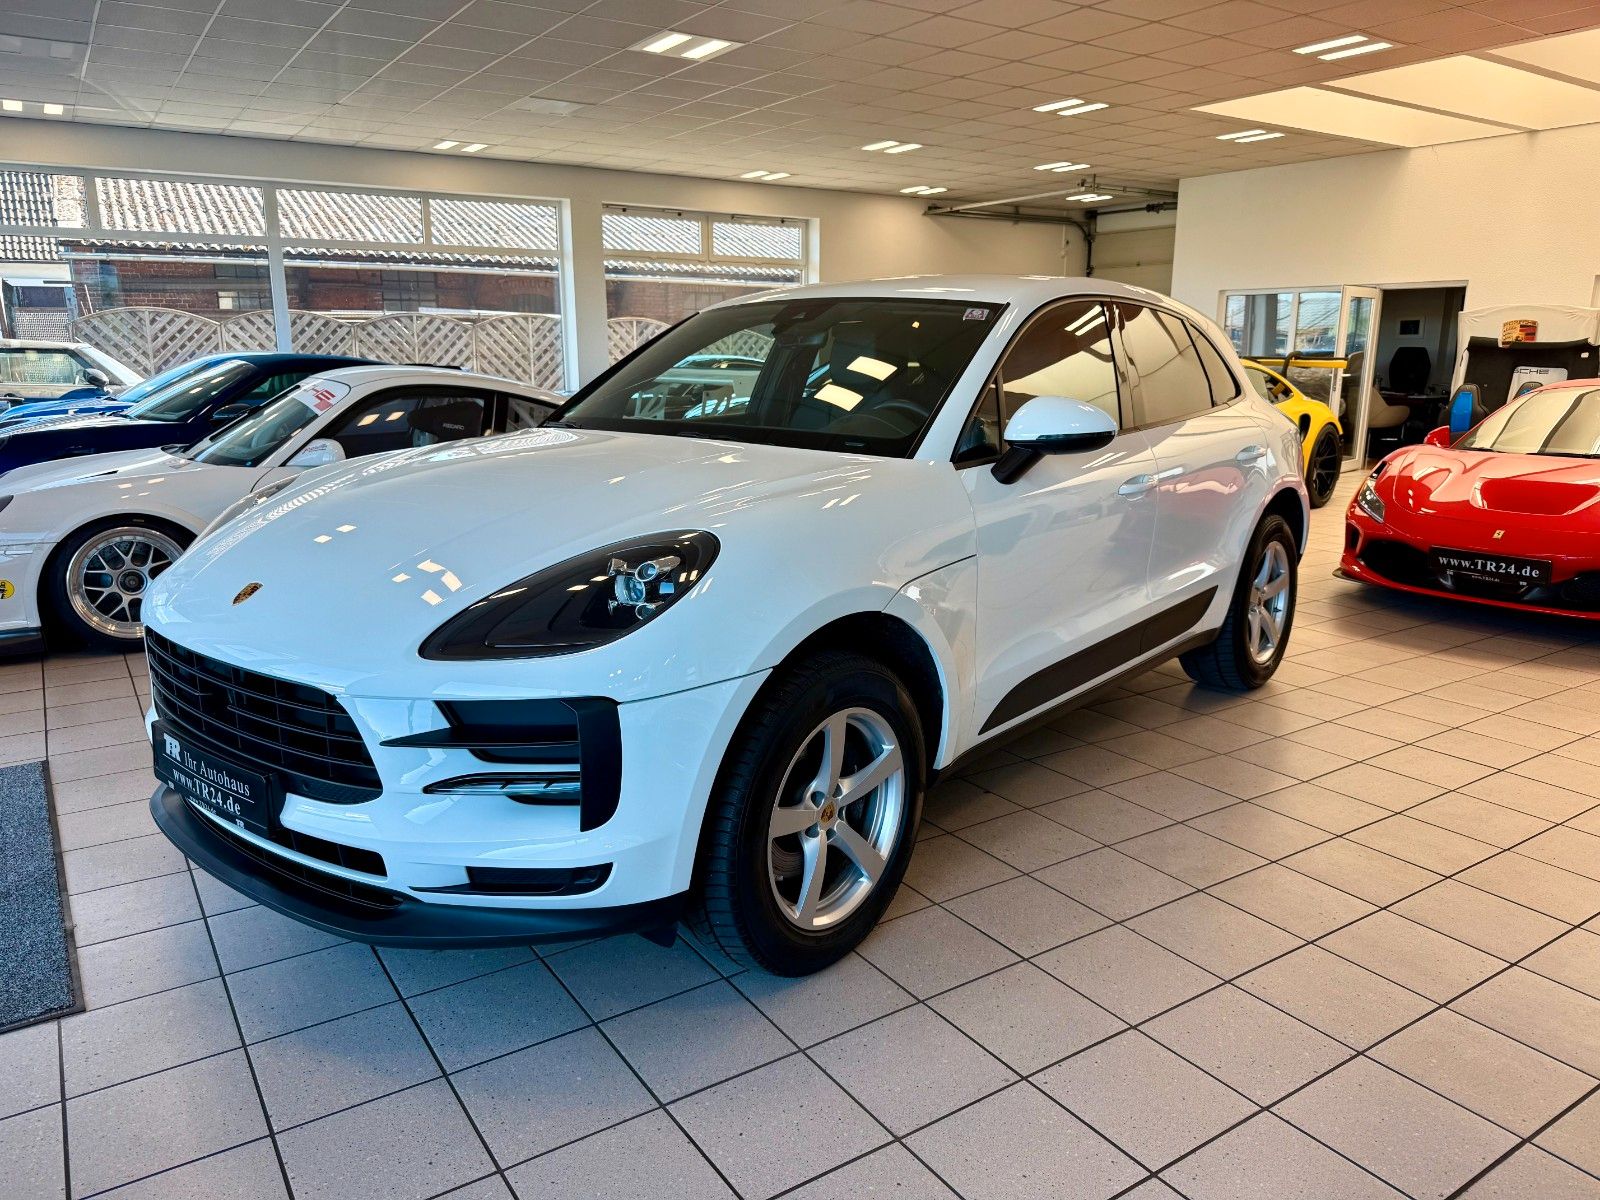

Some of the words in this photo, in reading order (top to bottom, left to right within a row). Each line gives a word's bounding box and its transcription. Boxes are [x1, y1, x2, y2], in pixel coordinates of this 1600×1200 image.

[1438, 556, 1540, 578] www.TR24.de
[173, 769, 241, 816] www.TR24.de
[184, 750, 197, 772] Ihr
[200, 760, 250, 797] Autohaus
